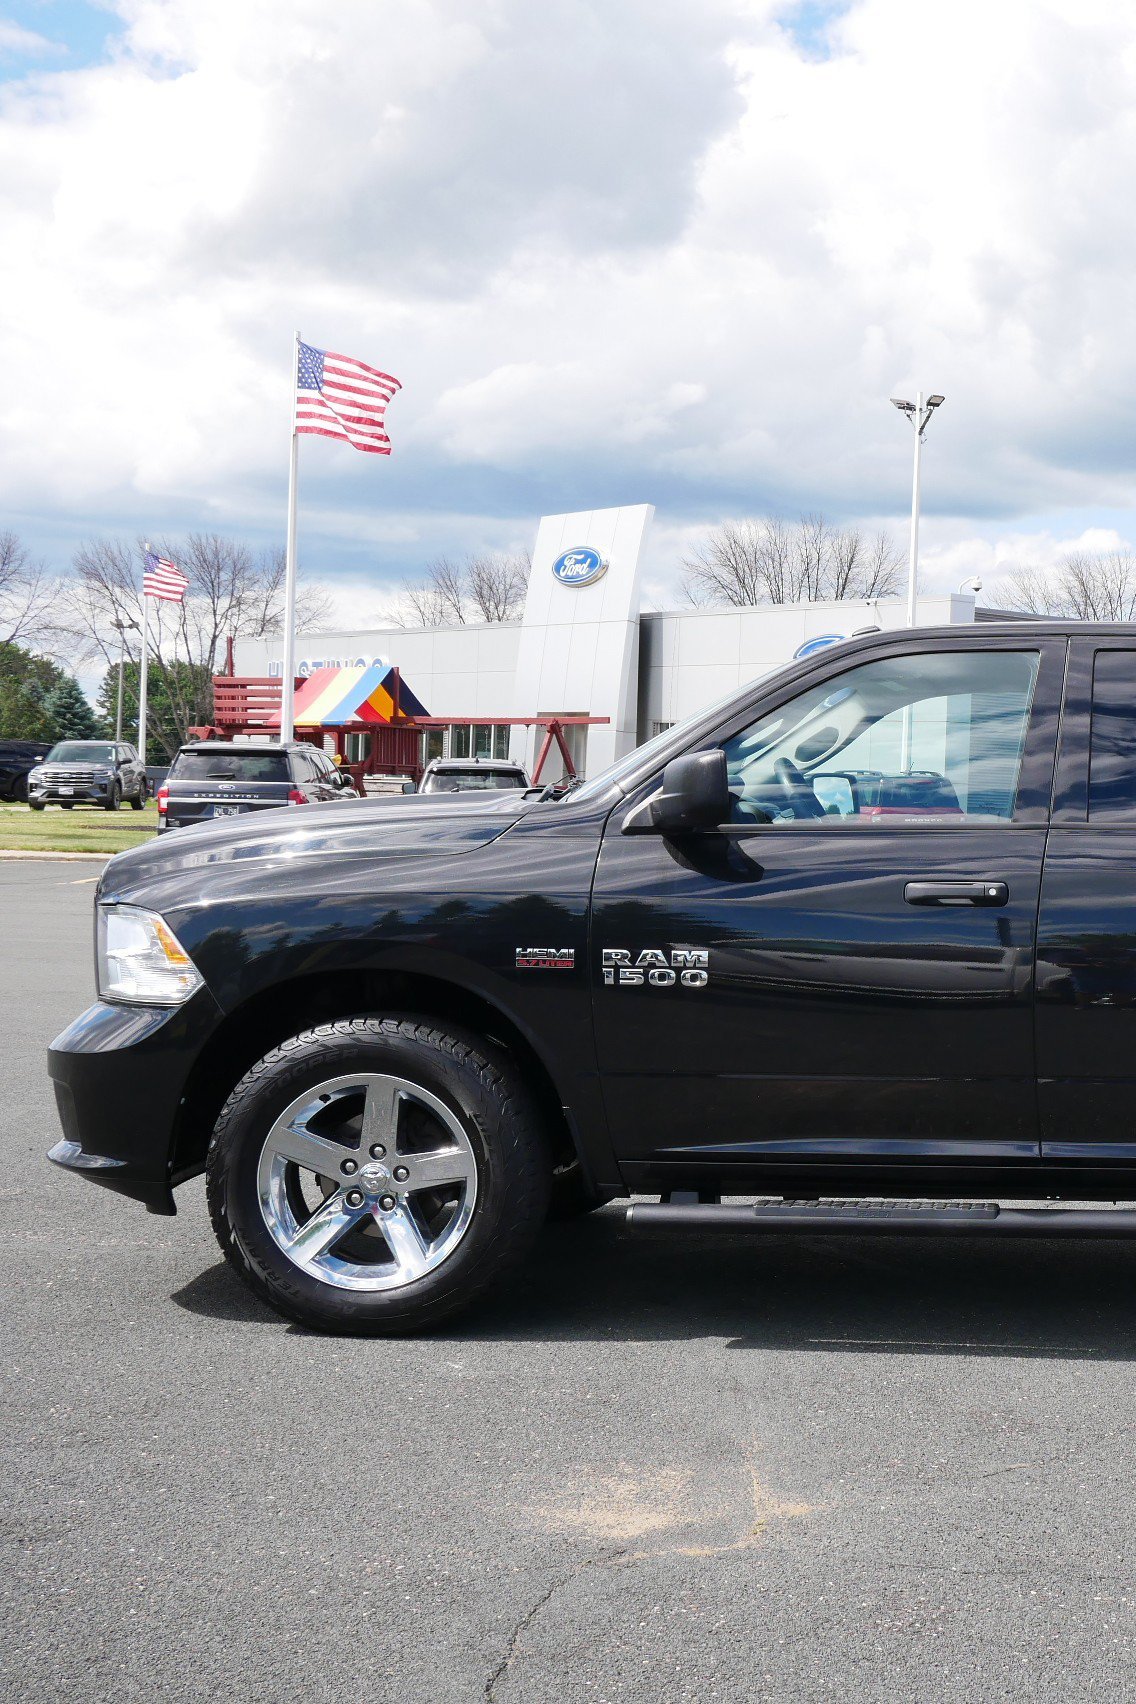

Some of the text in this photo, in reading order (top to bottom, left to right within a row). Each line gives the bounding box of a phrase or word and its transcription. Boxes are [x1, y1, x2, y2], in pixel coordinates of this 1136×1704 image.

[559, 553, 592, 577] Ford
[516, 948, 575, 959] HEMI
[602, 949, 709, 967] RAM
[602, 968, 709, 987] 1500
